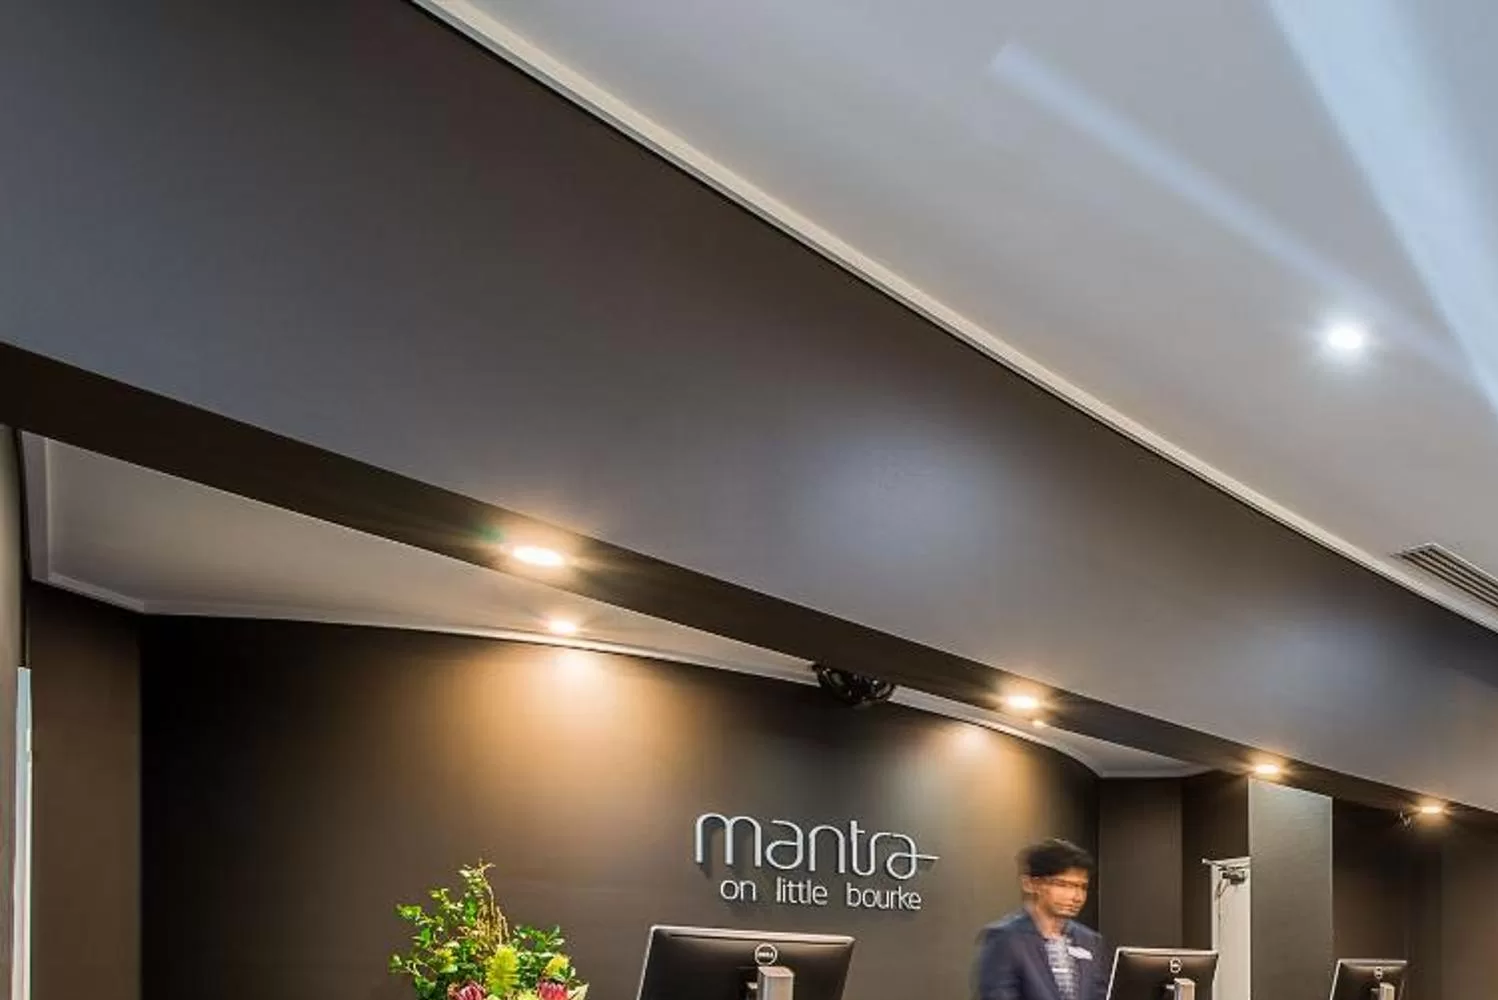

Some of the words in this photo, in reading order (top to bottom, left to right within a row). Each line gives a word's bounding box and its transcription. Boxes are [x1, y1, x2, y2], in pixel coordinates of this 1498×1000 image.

[694, 812, 940, 880] mantra
[720, 879, 757, 901] on
[776, 876, 829, 905] little
[846, 882, 922, 910] bourke
